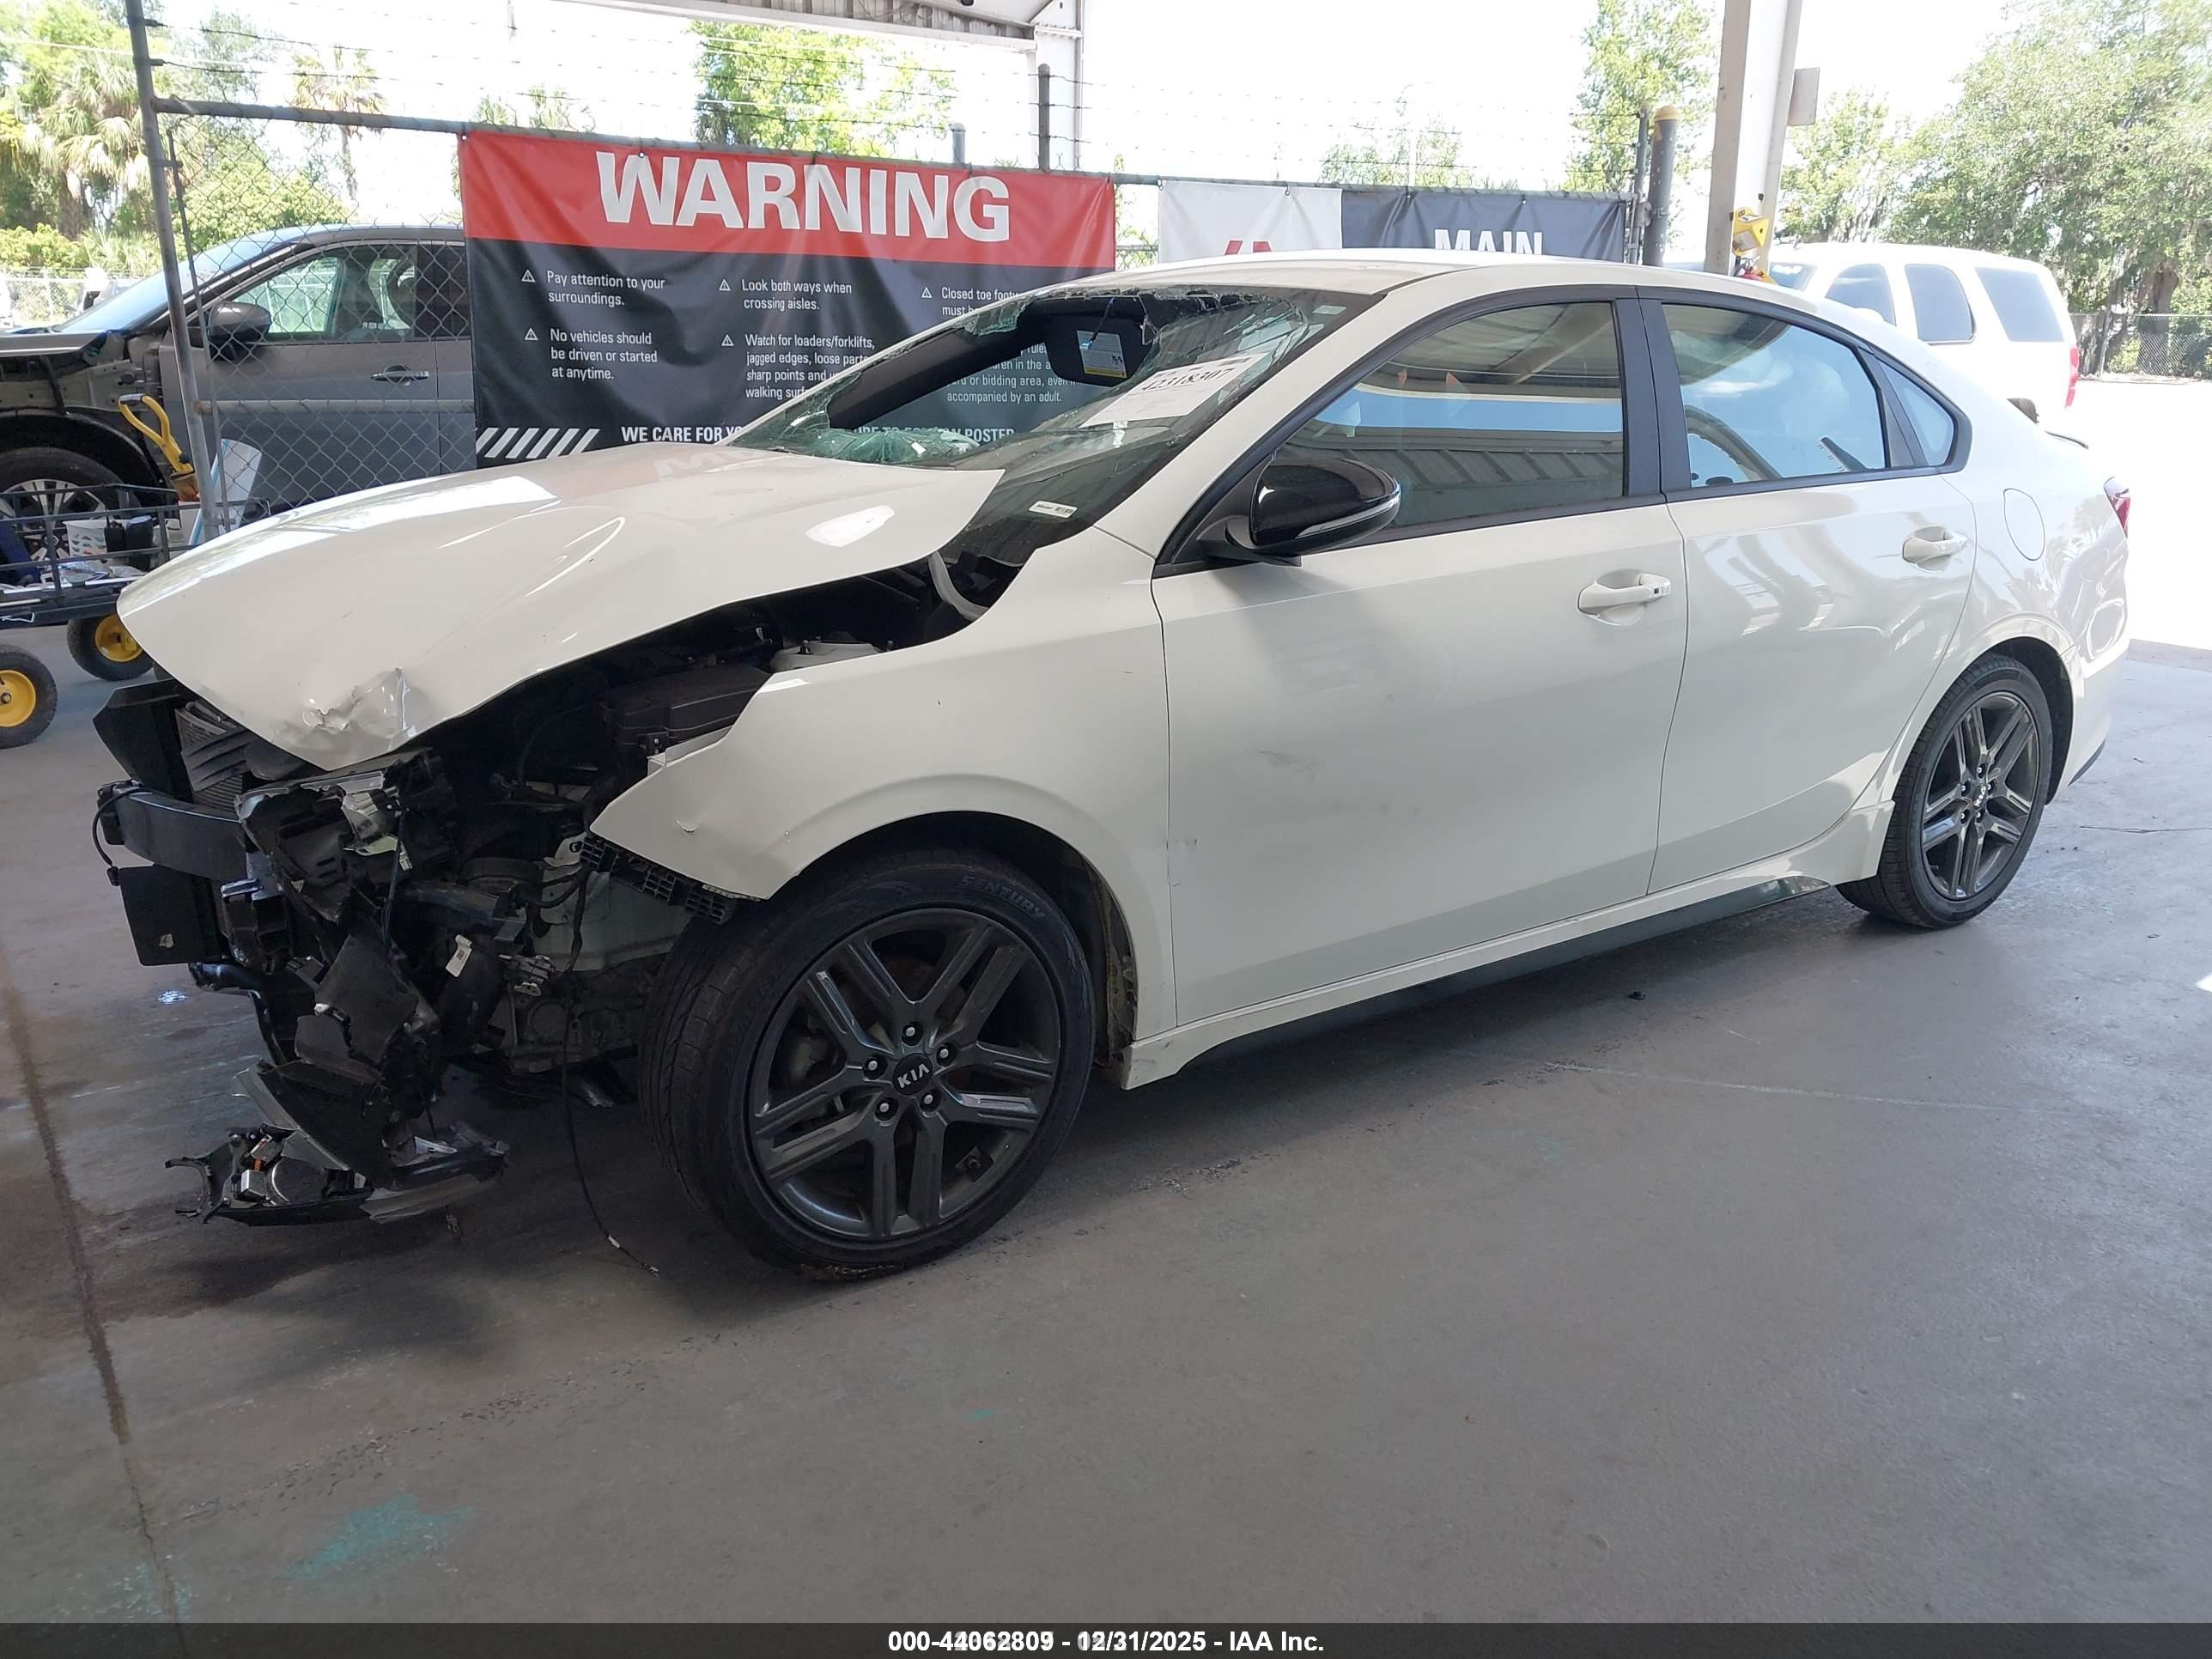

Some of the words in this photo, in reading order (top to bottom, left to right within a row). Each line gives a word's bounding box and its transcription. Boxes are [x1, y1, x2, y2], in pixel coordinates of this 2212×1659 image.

[596, 150, 1011, 242] WARNING
[546, 270, 568, 287] Pay
[570, 273, 623, 289] attention
[626, 276, 638, 289] to
[641, 278, 666, 292] your
[741, 278, 769, 292] Look
[771, 278, 792, 292] both
[793, 281, 821, 295] ways
[823, 281, 853, 294] when
[548, 292, 625, 307] surroundings.
[941, 286, 974, 300] Closed
[976, 289, 992, 301] toe
[744, 297, 785, 311] crossing
[787, 298, 820, 310] aisles.
[942, 305, 965, 316] must
[550, 328, 568, 343] No
[570, 330, 614, 343] vehicles
[617, 331, 653, 344] should
[744, 333, 778, 346] Watch
[778, 334, 793, 346] for
[794, 334, 875, 350] loaders/forklifts,
[550, 347, 566, 360] be
[568, 348, 603, 361] driven
[605, 351, 617, 362] or
[619, 349, 658, 362] started
[746, 351, 776, 367] jagged
[779, 352, 811, 366] edges,
[814, 352, 841, 364] loose
[1015, 357, 1024, 370] in
[1026, 357, 1042, 370] the
[551, 367, 563, 378] at
[566, 367, 615, 381] anytime.
[746, 369, 772, 383] sharp
[775, 369, 805, 383] points
[807, 369, 827, 381] and
[969, 377, 980, 386] or
[982, 374, 1017, 389] bidding
[1020, 377, 1045, 388] area,
[745, 386, 782, 400] walking
[947, 391, 1007, 404] accompanied
[1010, 391, 1021, 404] by
[1024, 392, 1036, 402] an
[1038, 391, 1062, 402] adult.
[621, 426, 648, 441] WE
[652, 426, 692, 441] CARE
[696, 426, 723, 441] FOR
[897, 1063, 930, 1089] KIA
